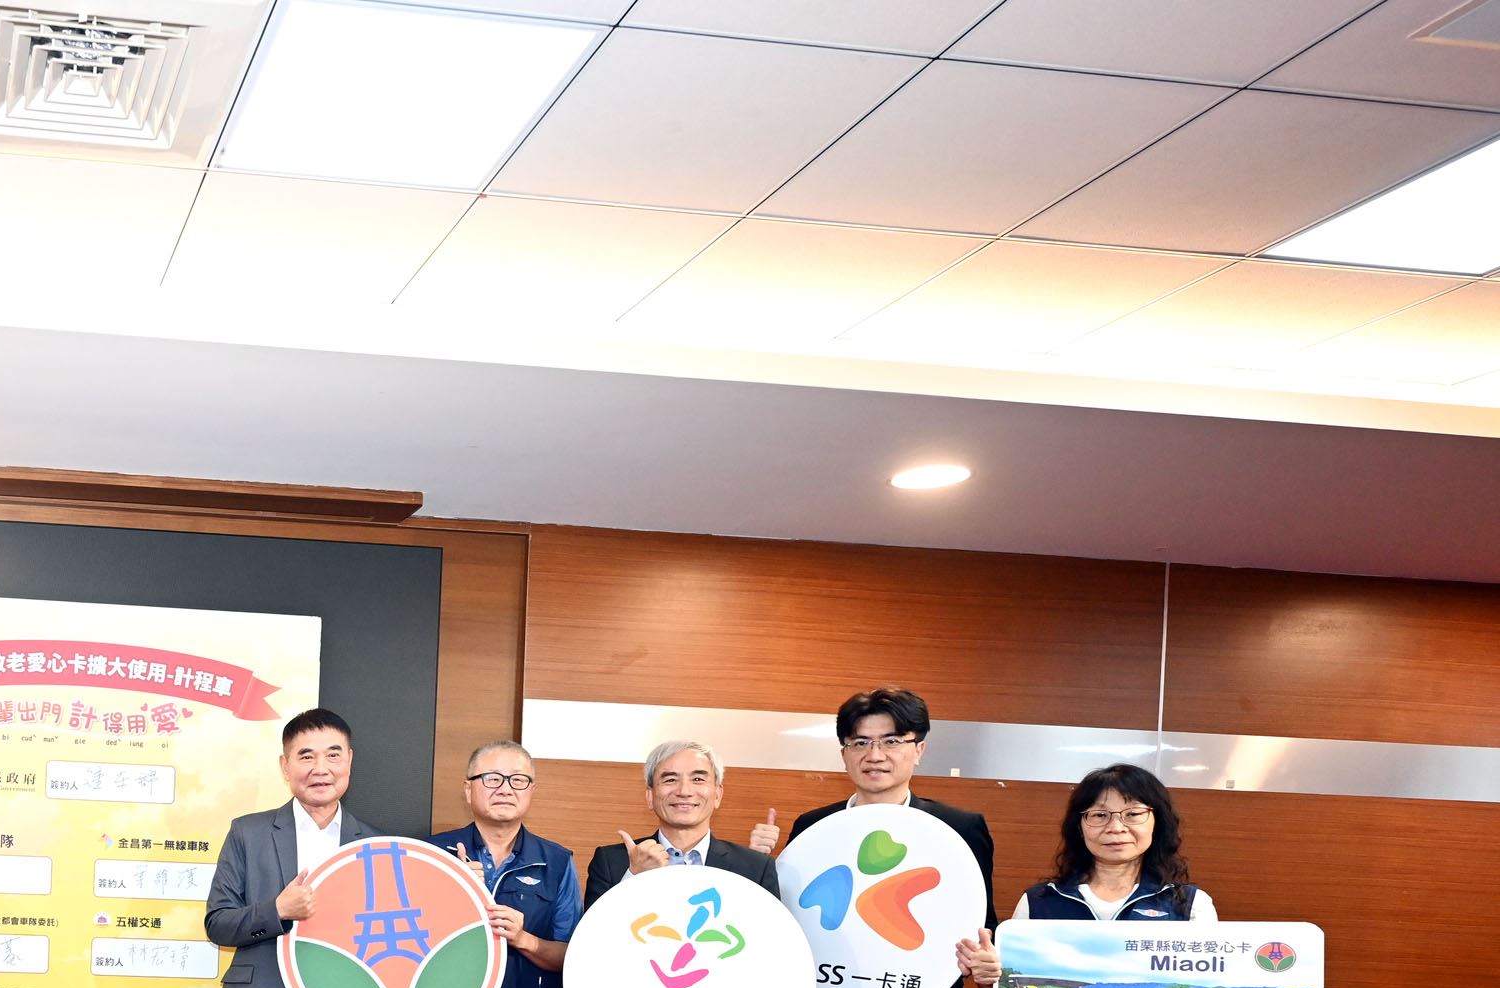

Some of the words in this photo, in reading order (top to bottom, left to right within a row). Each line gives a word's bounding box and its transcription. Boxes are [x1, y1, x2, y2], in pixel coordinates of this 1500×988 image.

[50, 780, 79, 791] 簽約人
[118, 838, 210, 852] 金昌第一無線車隊
[98, 878, 127, 889] 簽約人
[116, 916, 162, 929] 五權交通
[1124, 939, 1253, 954] 苗栗縣敬老愛心卡
[95, 957, 124, 967] 簽約人
[1150, 954, 1225, 973] Miaoli
